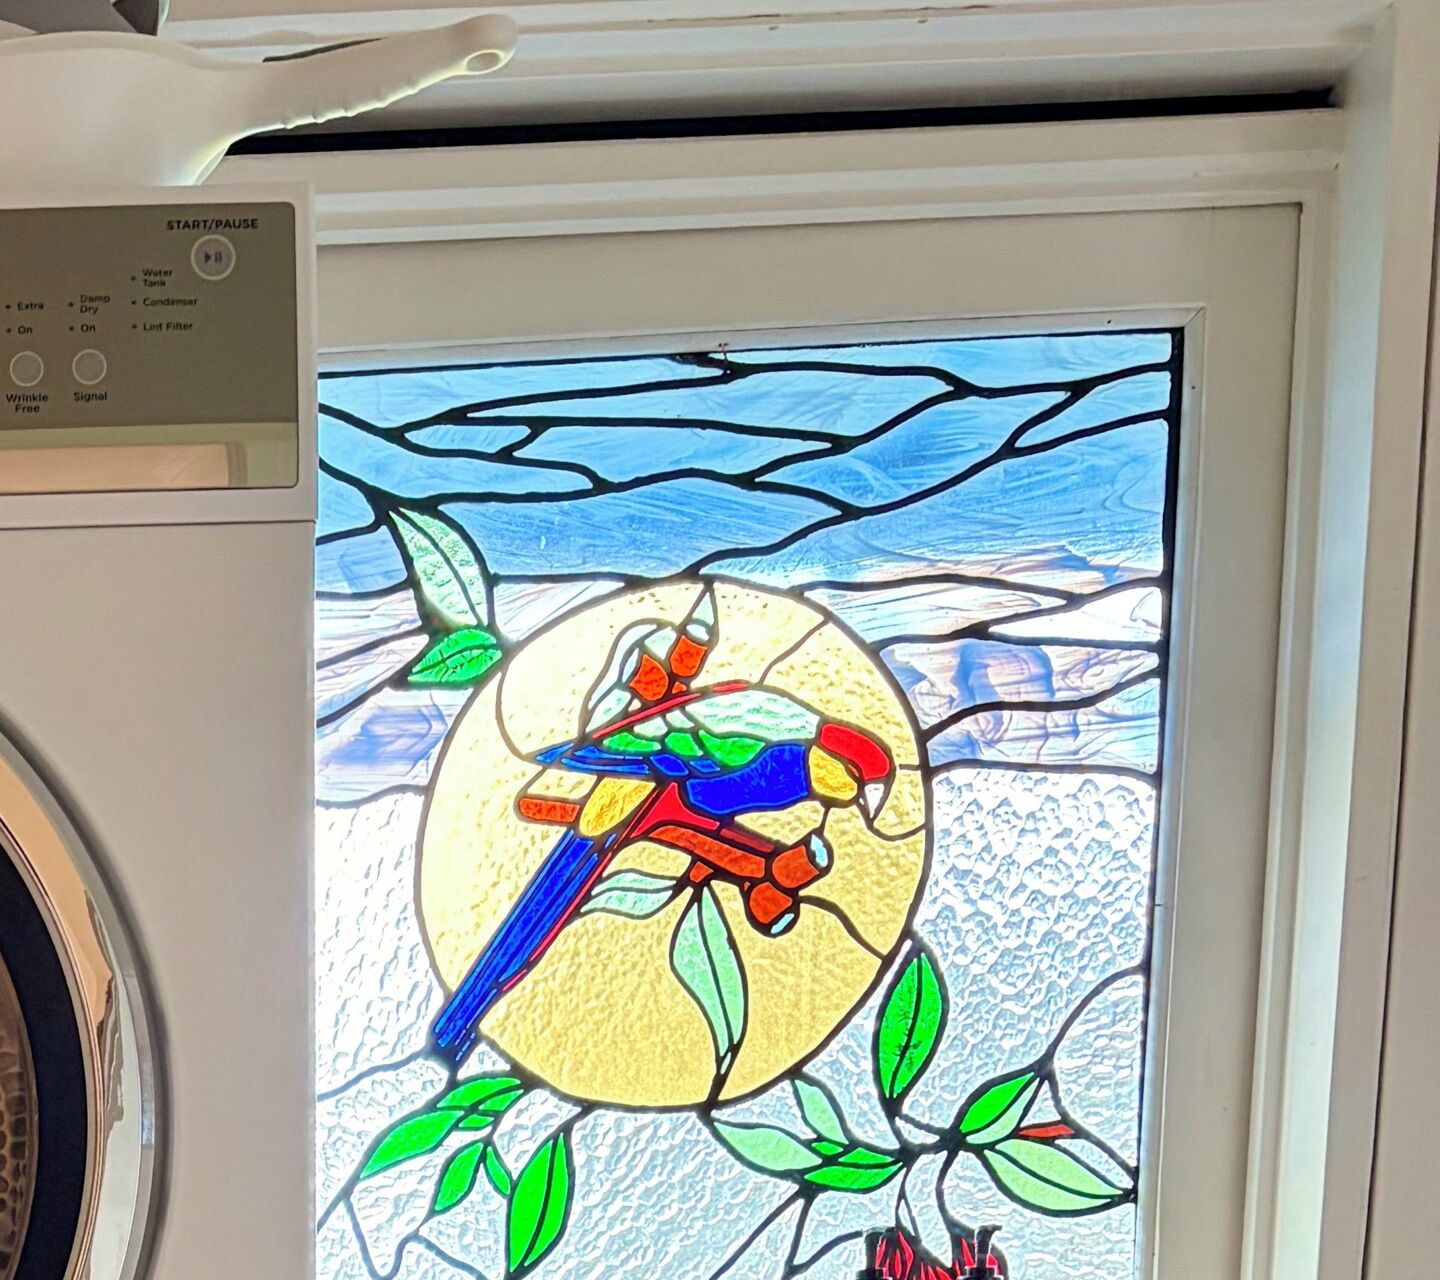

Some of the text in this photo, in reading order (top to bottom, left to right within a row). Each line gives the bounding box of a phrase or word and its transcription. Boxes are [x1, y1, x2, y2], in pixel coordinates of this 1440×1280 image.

[166, 218, 259, 231] START/PAUSE
[17, 302, 44, 311] Extra
[80, 305, 98, 315] Dry
[17, 325, 33, 335] On
[80, 324, 96, 333] On
[6, 393, 49, 403] Wrinkle
[73, 391, 108, 403] Signal
[15, 403, 40, 413] Free
